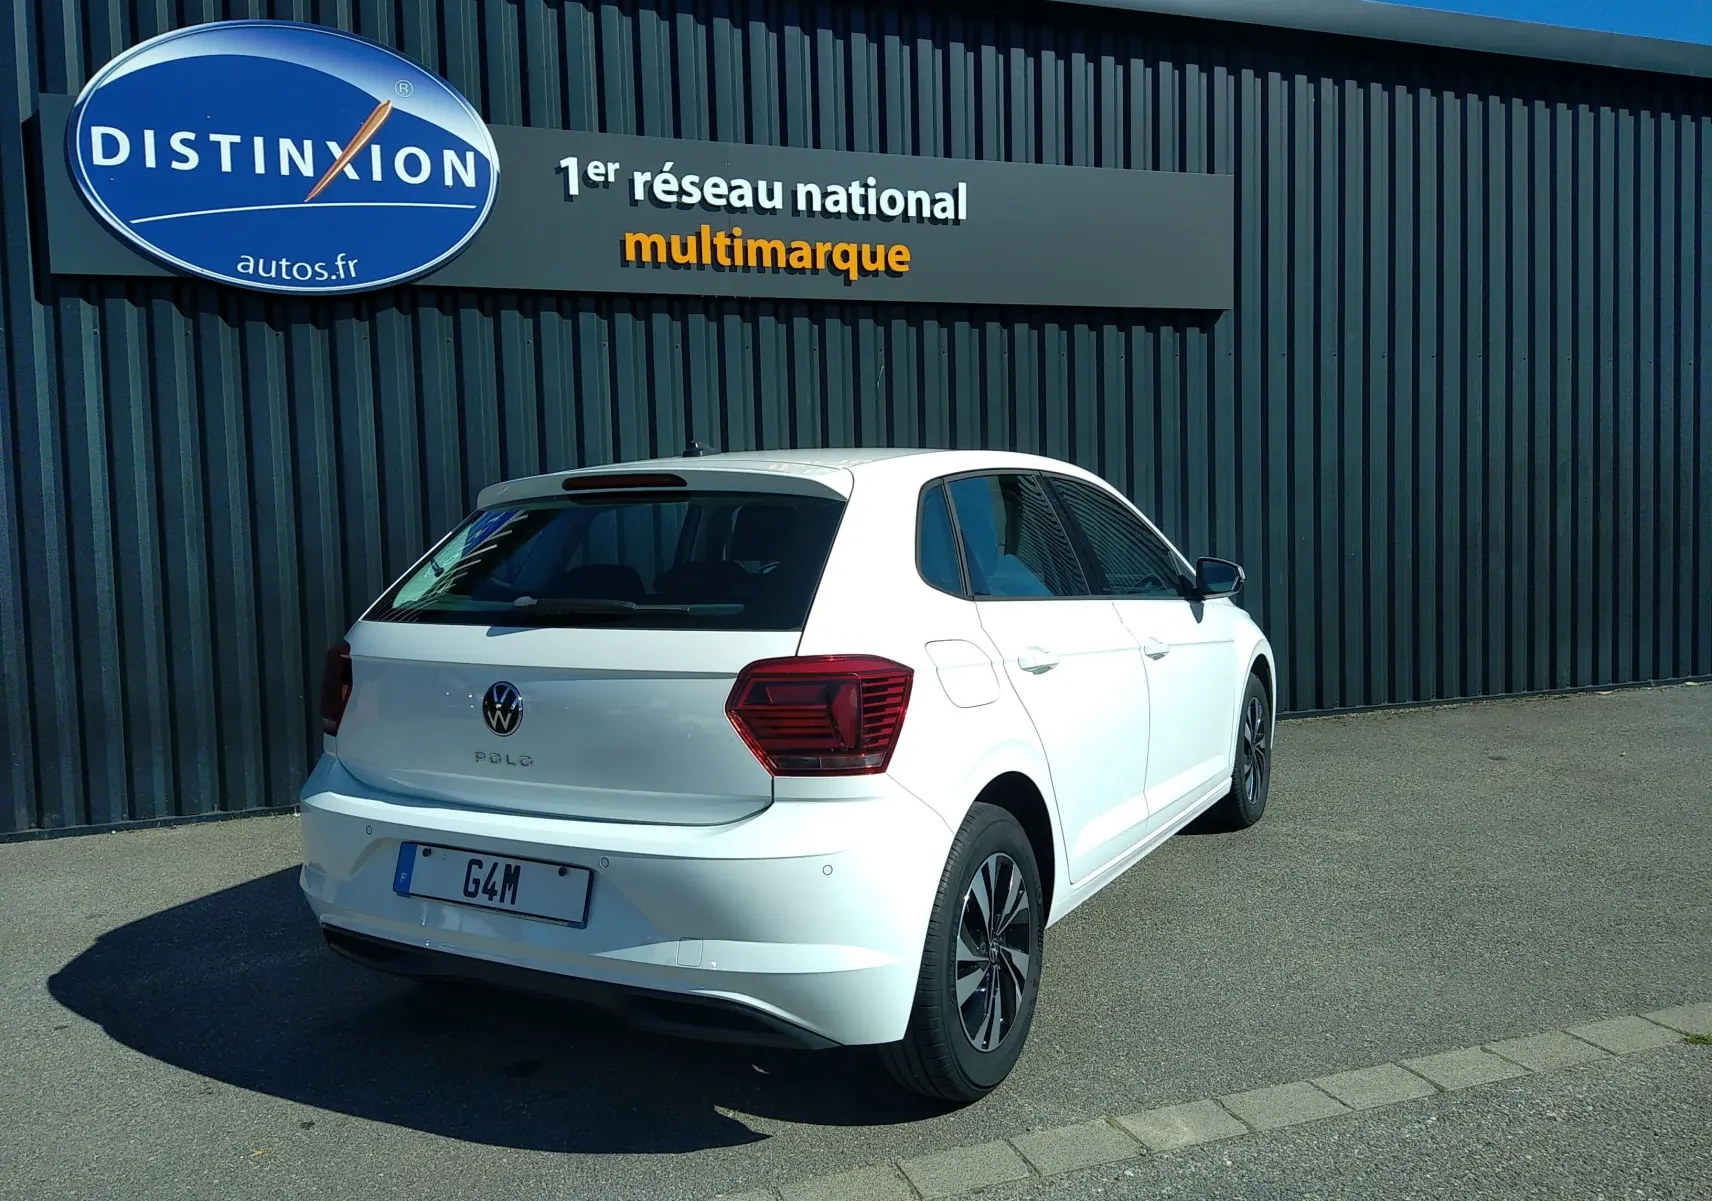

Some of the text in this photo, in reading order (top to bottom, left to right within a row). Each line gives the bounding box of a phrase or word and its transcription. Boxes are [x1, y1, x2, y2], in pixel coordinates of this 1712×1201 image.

[90, 125, 477, 188] DISTINXION
[633, 161, 783, 211] réseau
[796, 177, 968, 221] national
[236, 252, 359, 281] autos.fr
[623, 224, 911, 281] multimarque
[474, 752, 533, 767] POLO
[463, 858, 521, 905] G4M
